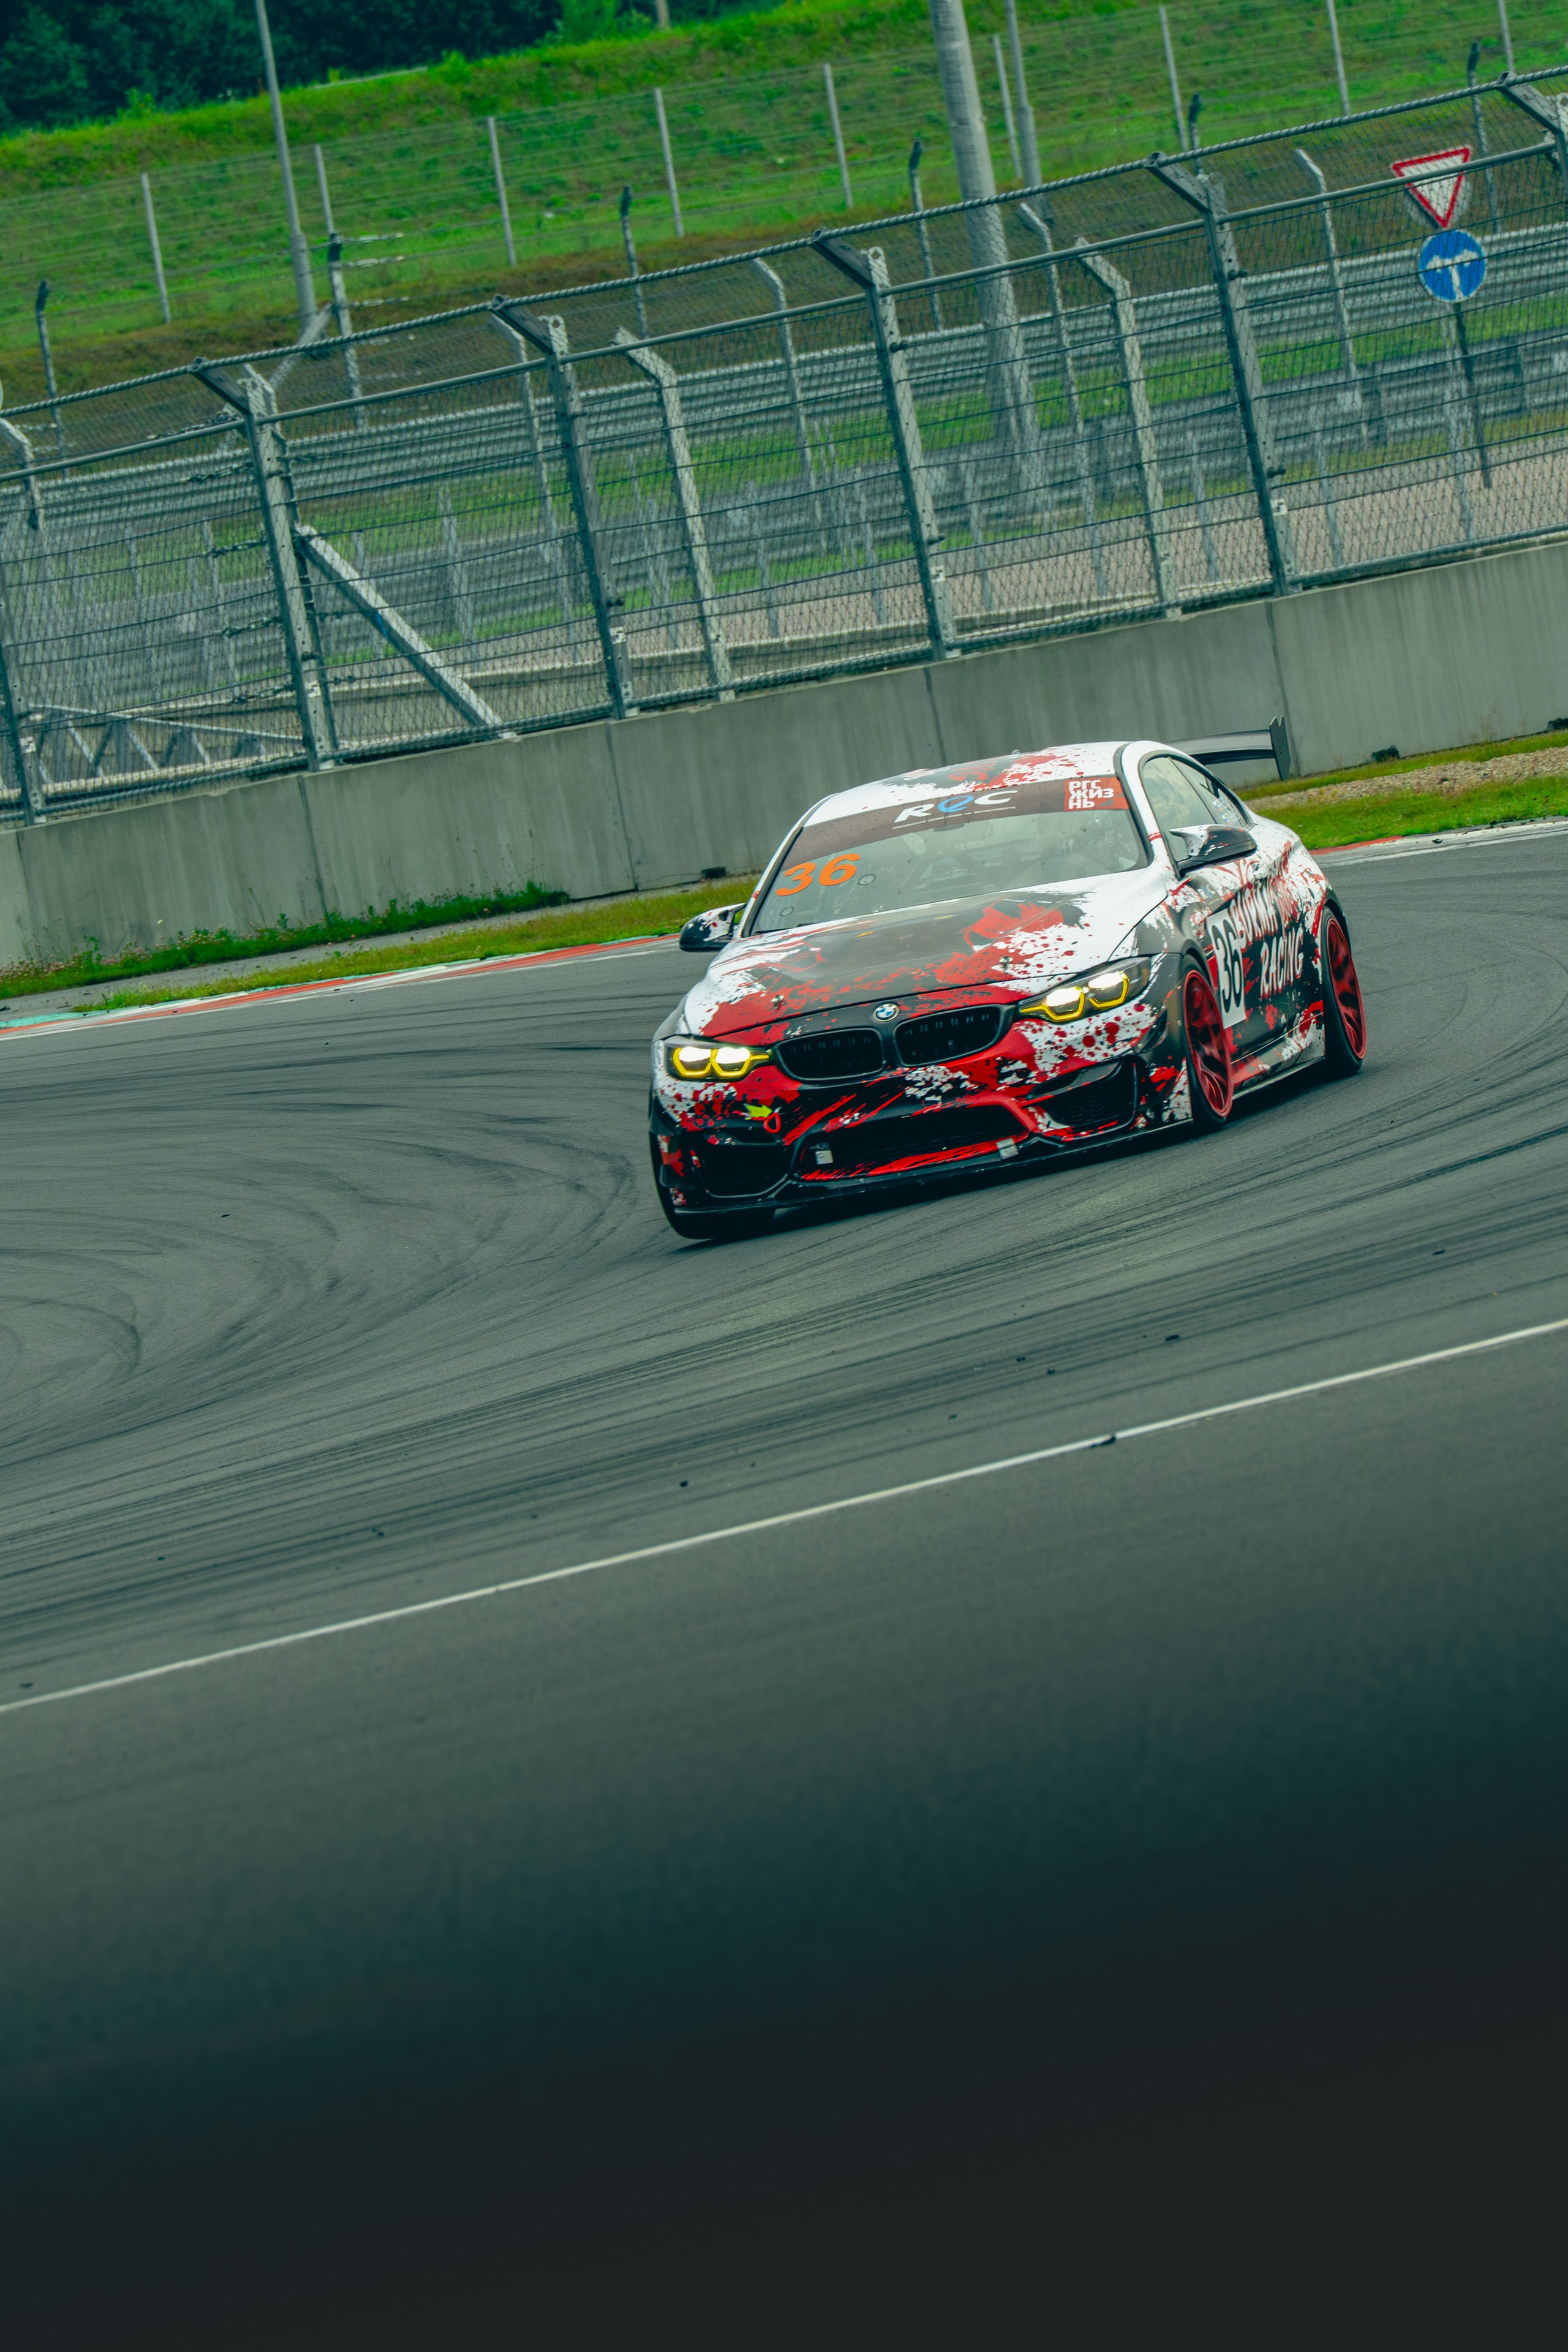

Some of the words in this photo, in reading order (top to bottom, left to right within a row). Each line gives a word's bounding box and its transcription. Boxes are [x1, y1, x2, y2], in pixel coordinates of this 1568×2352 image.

[1069, 780, 1101, 791] РГС
[1069, 788, 1114, 800] ЖИЗ
[1068, 799, 1095, 809] НЬ
[775, 853, 861, 896] 36
[1212, 919, 1243, 1014] 36
[1261, 924, 1304, 1001] RACING
